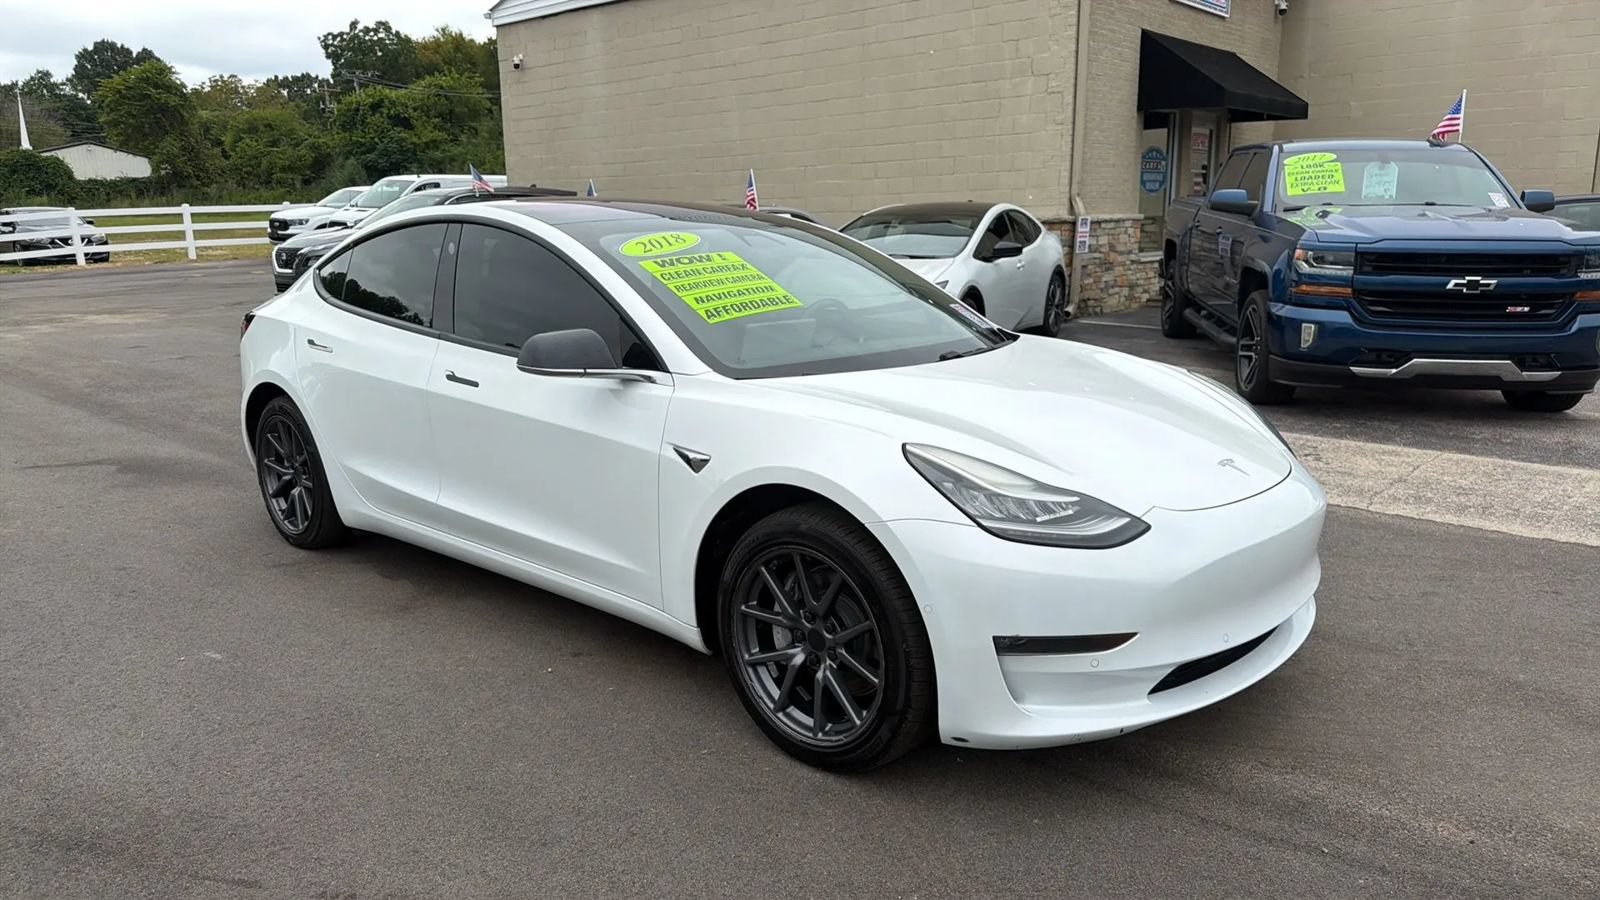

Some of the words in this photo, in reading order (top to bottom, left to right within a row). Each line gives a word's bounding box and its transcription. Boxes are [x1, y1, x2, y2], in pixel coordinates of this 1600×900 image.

[635, 232, 687, 254] 2018
[660, 267, 702, 282] CLEAN
[702, 262, 750, 277] CARFAX
[674, 277, 727, 293] REARVIEW
[727, 273, 766, 285] CAMERA
[694, 285, 776, 305] NAVIGATION
[704, 294, 794, 320] AFFORDABLE
